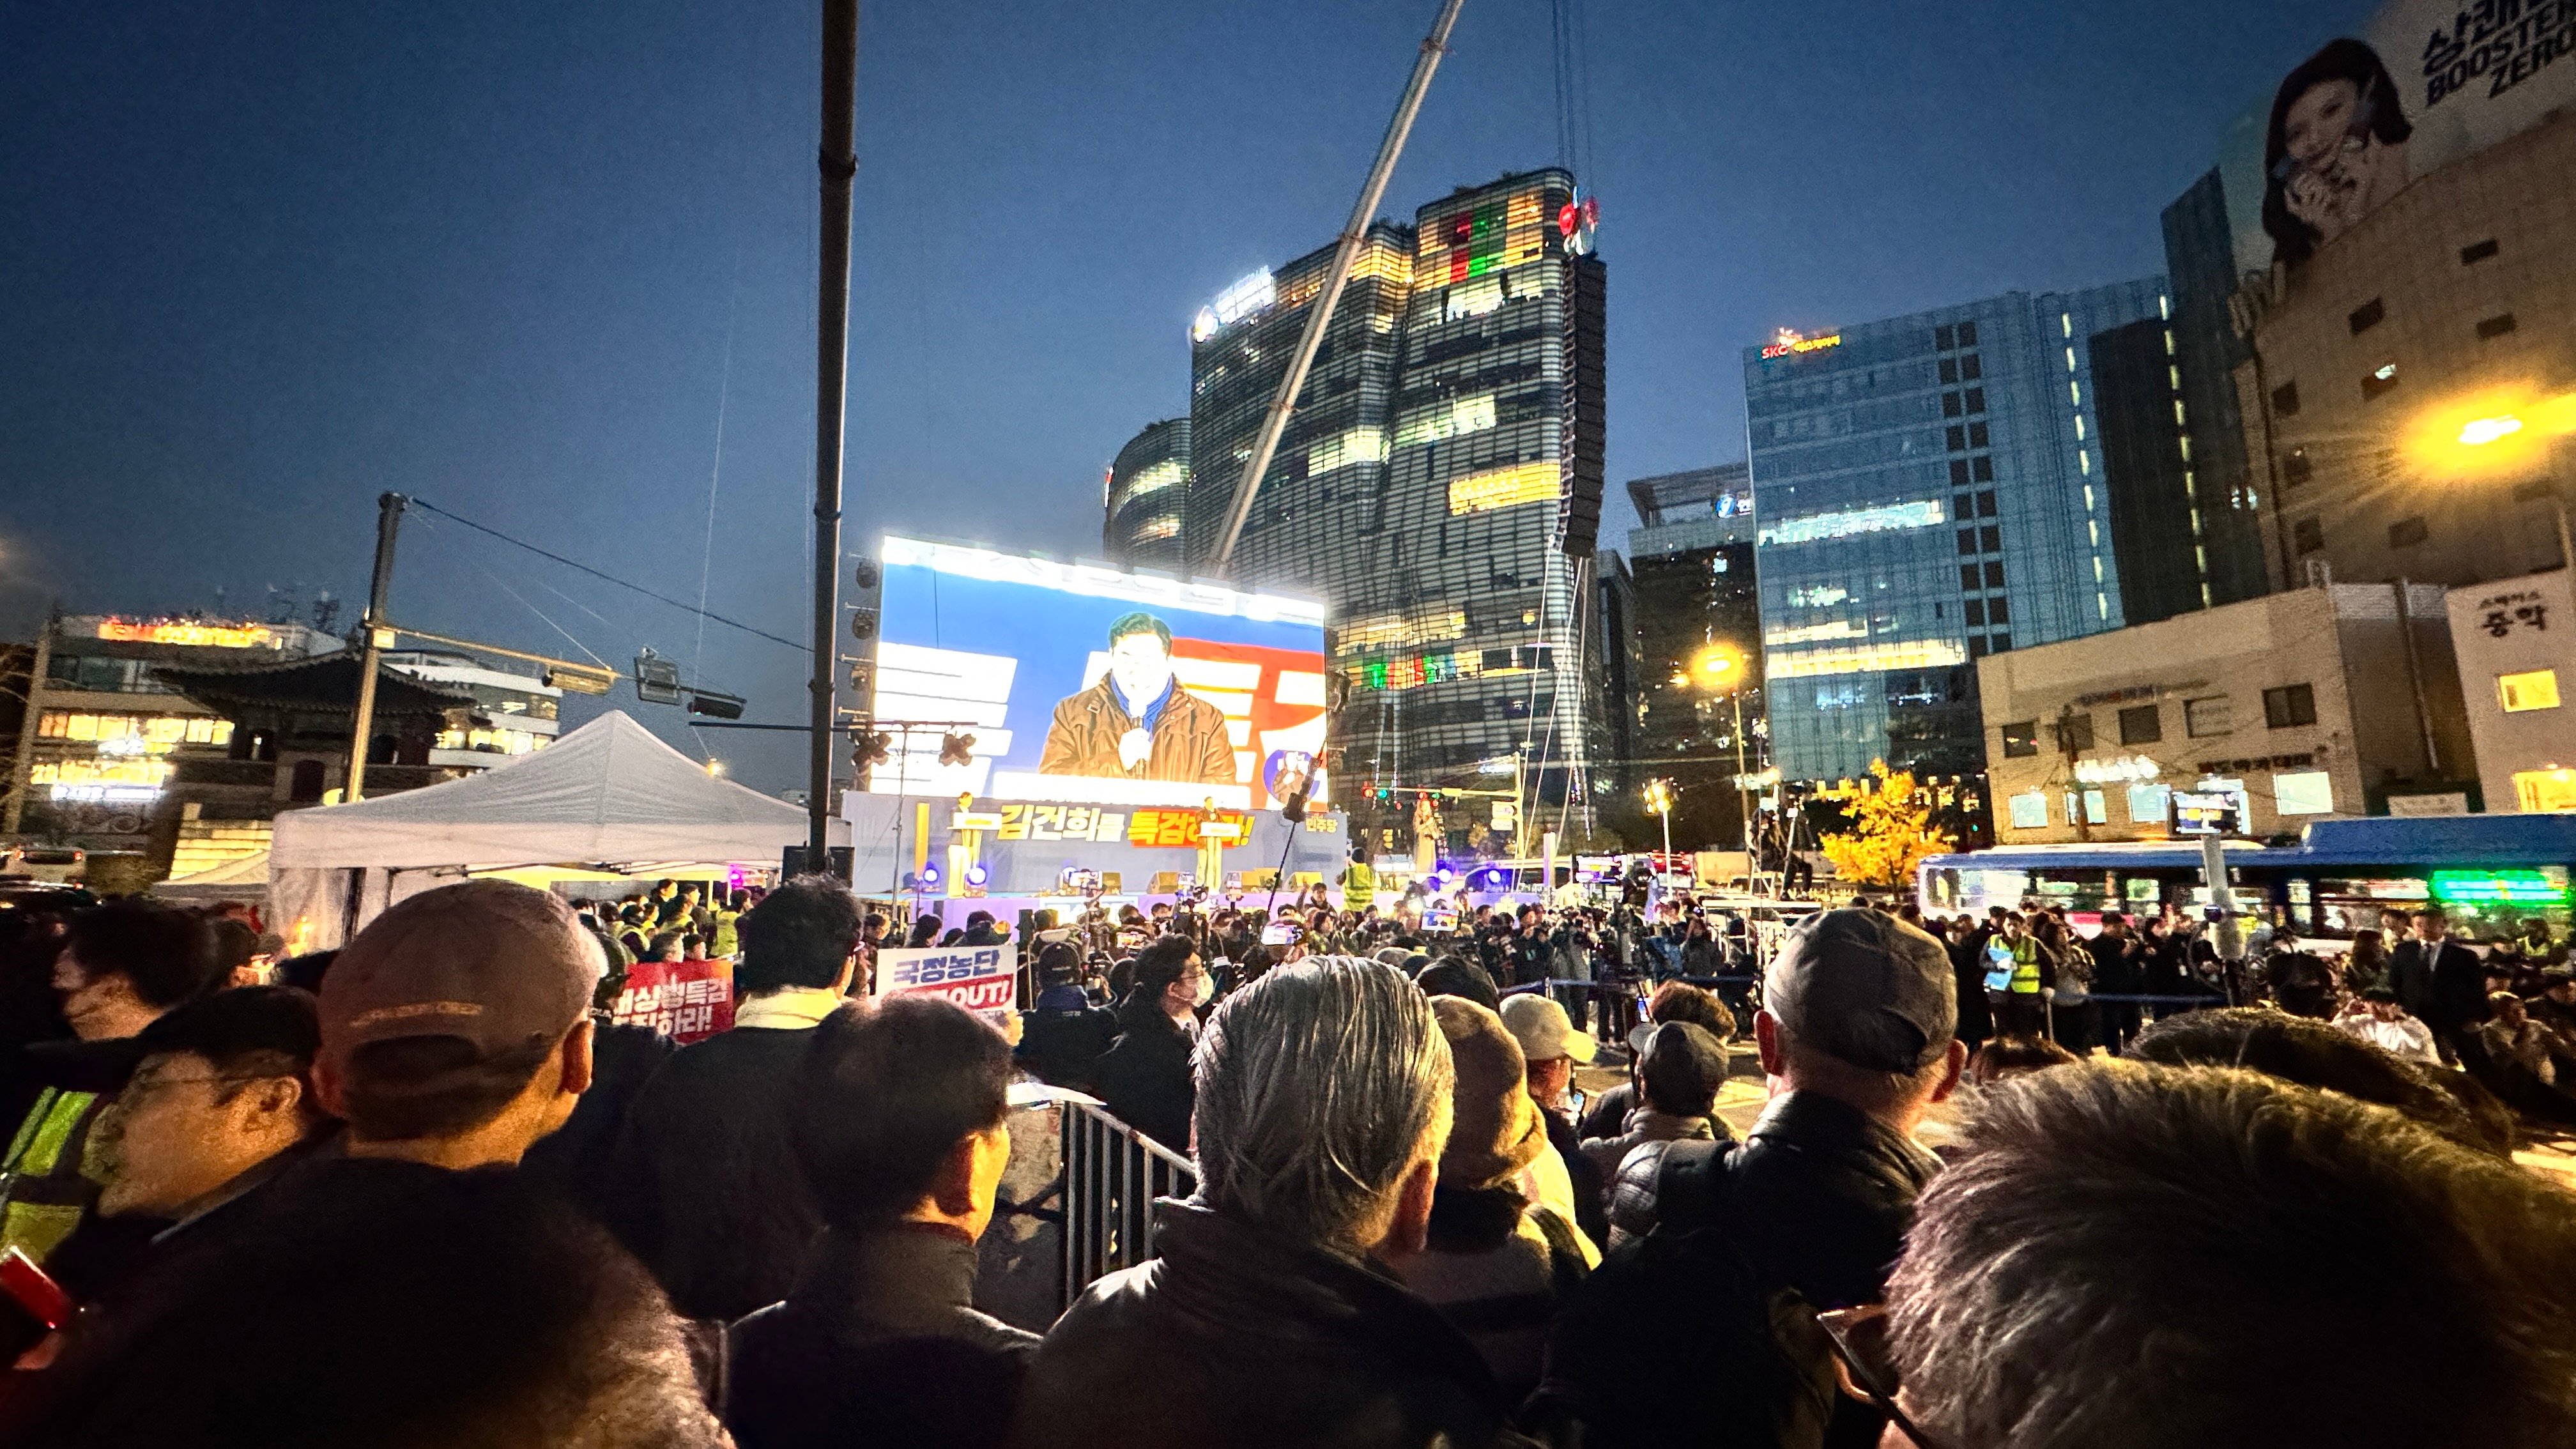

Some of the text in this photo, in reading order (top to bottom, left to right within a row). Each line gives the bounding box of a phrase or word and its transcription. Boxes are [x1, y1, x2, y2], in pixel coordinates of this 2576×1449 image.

[2423, 0, 2549, 75] 상쾌
[2488, 24, 2576, 99] ZERO
[1762, 345, 1788, 359] SKC
[997, 804, 1125, 841] 김건희를
[1305, 817, 1338, 833] 민주당
[893, 949, 1000, 985] 국정농단
[949, 980, 1009, 1006] OUT!
[612, 1005, 714, 1035] 하라!
